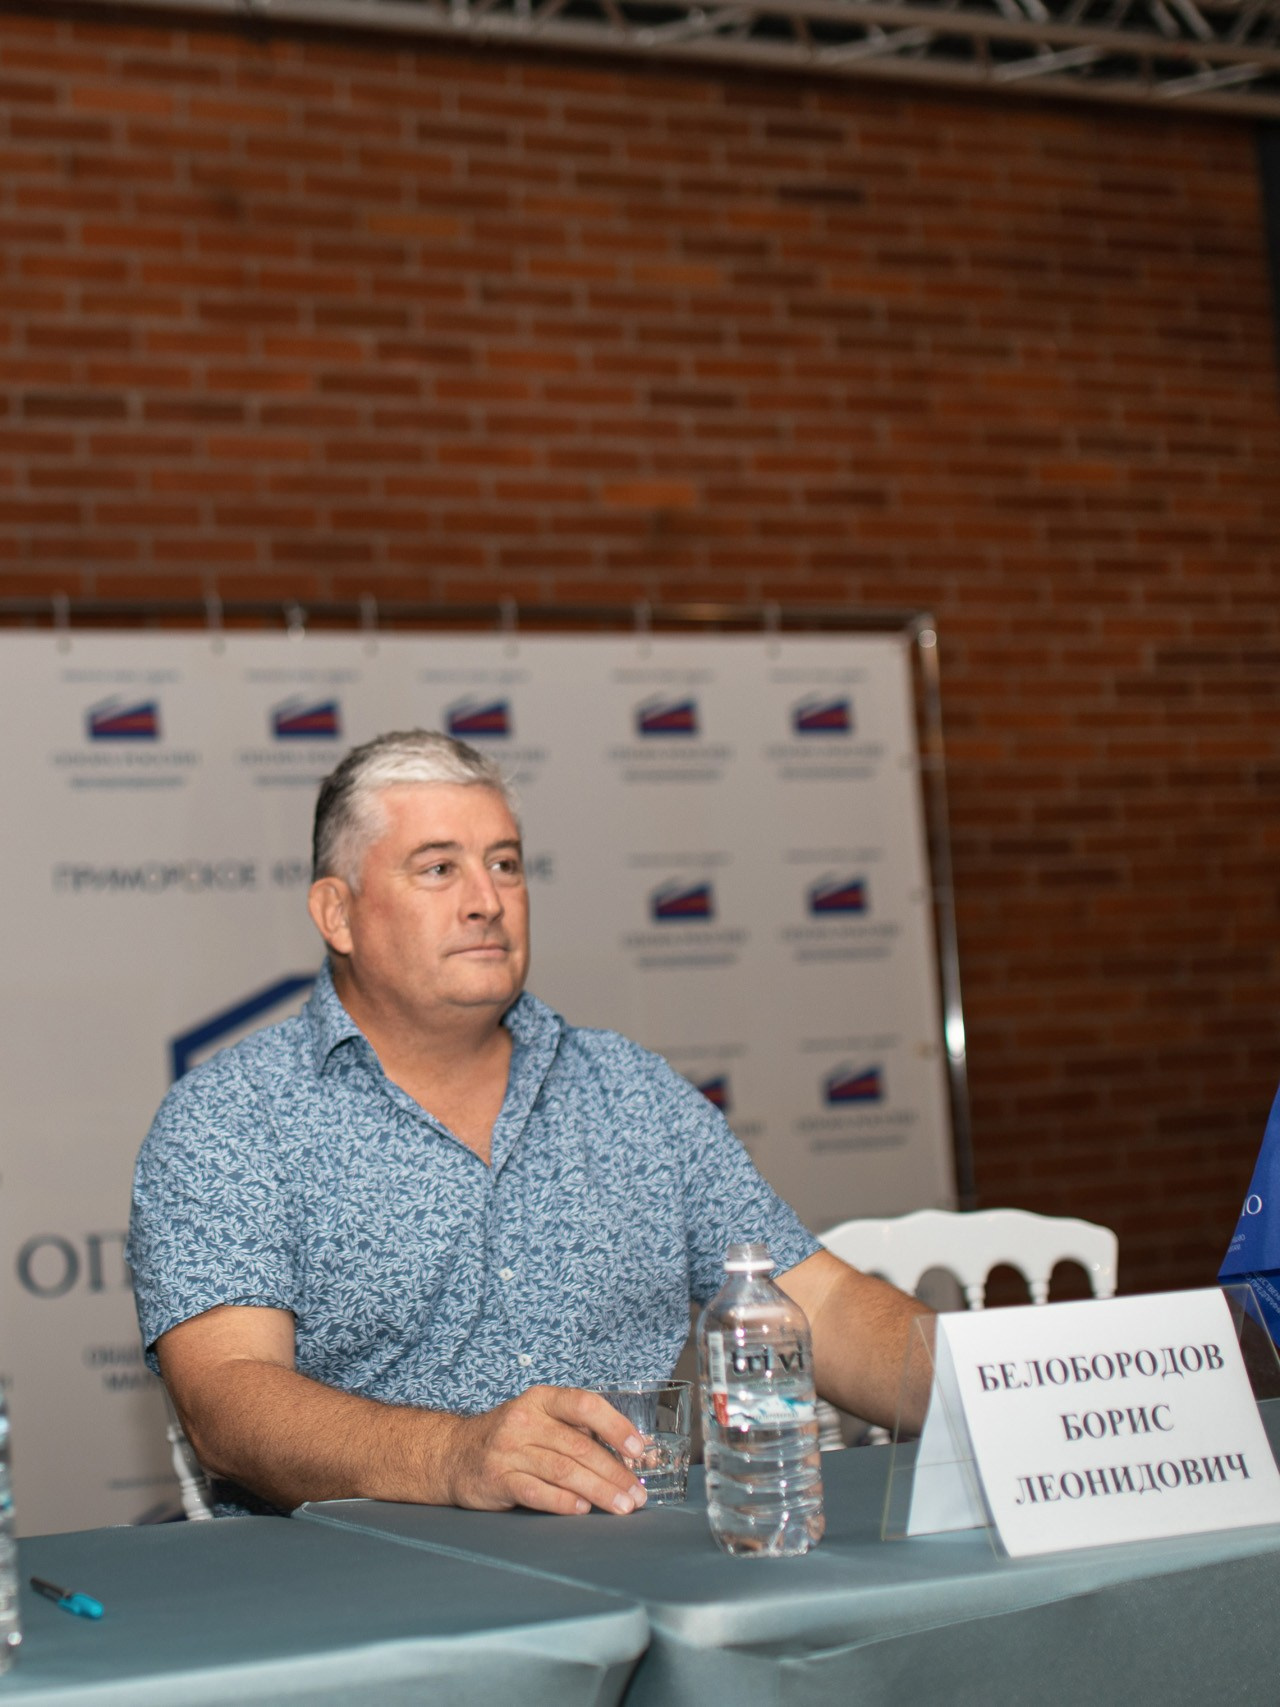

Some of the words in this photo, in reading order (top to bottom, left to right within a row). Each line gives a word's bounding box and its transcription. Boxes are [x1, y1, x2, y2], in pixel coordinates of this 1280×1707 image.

[976, 1343, 1225, 1392] БЕЛОБОРОДОВ
[1060, 1403, 1175, 1441] БОРИС
[1015, 1453, 1252, 1505] ЛЕОНИДОВИЧ
